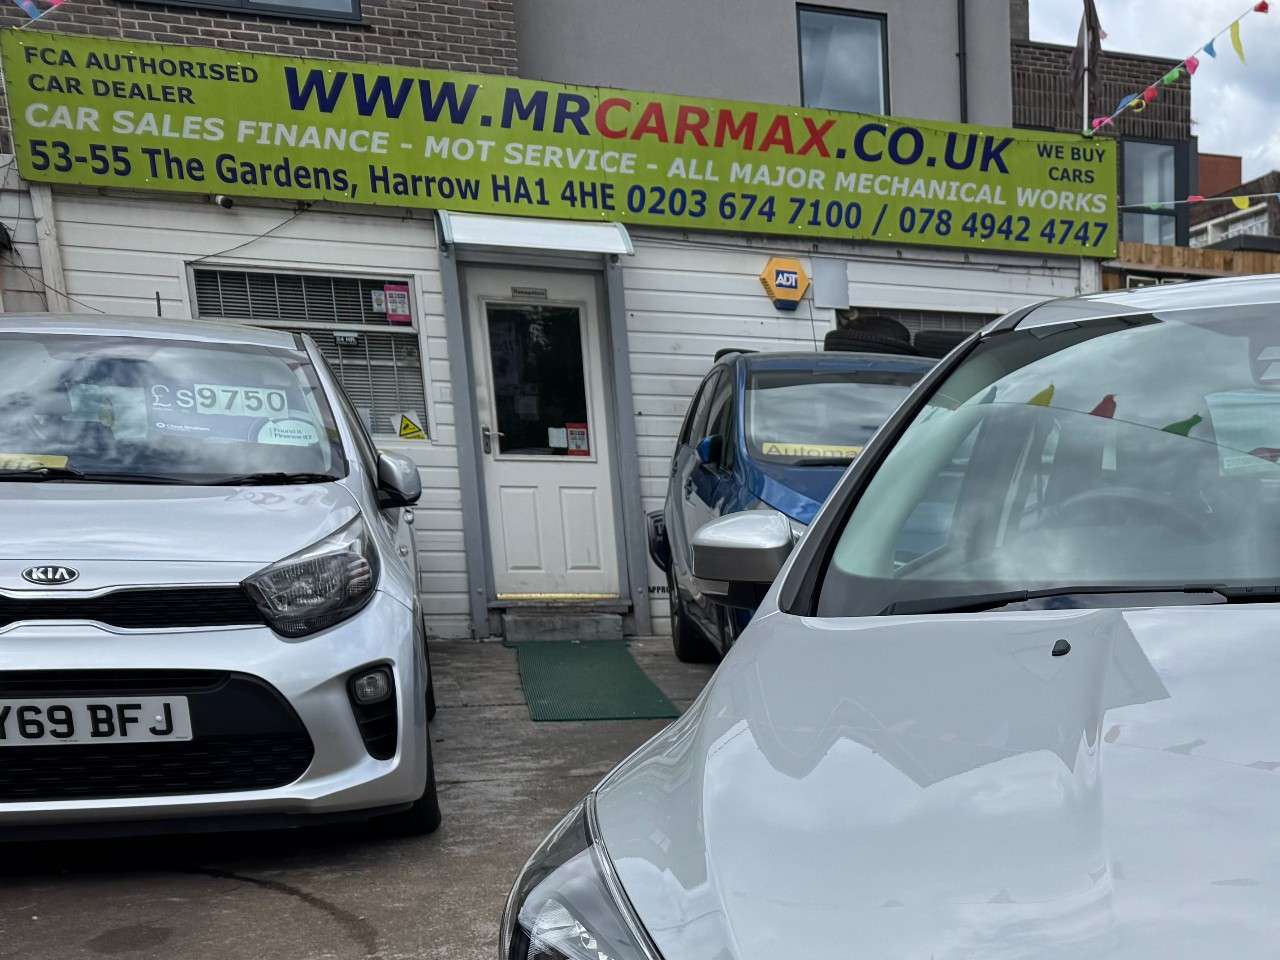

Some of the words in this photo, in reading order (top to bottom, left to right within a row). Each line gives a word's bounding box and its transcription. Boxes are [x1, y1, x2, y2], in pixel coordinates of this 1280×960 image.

[23, 46, 76, 68] FCA
[86, 51, 258, 83] AUTHORISED
[28, 73, 84, 95] CAR
[92, 79, 195, 104] DEALER
[284, 66, 1015, 174] WWW.MRCARMAX.CO.UK
[24, 103, 100, 132] CAR
[112, 110, 225, 141] SALES
[237, 120, 389, 154] FINANCE
[424, 135, 495, 161] MOT
[504, 142, 637, 174] SERVICE
[667, 157, 719, 181] ALL
[729, 162, 824, 190] MAJOR
[834, 172, 1007, 205] MECHANICAL
[1016, 187, 1107, 214] WORKS
[1037, 143, 1065, 160] WE
[1071, 147, 1106, 163] BUY
[1048, 167, 1095, 184] CARS
[29, 139, 131, 177] 53-55
[141, 147, 205, 181] The
[215, 153, 358, 199] Gardens,
[368, 164, 480, 200] Harrow
[491, 174, 550, 205] HA1
[560, 180, 615, 211] 4HE
[627, 184, 707, 218] 0203
[719, 192, 775, 222] 674
[788, 197, 862, 228] 7100
[872, 203, 888, 236] /
[899, 206, 952, 236] 078
[962, 212, 1031, 242] 4942
[1040, 219, 1108, 247] 4747
[775, 272, 797, 287] ADT
[31, 567, 70, 580] KIA
[87, 702, 174, 738] BFJ
